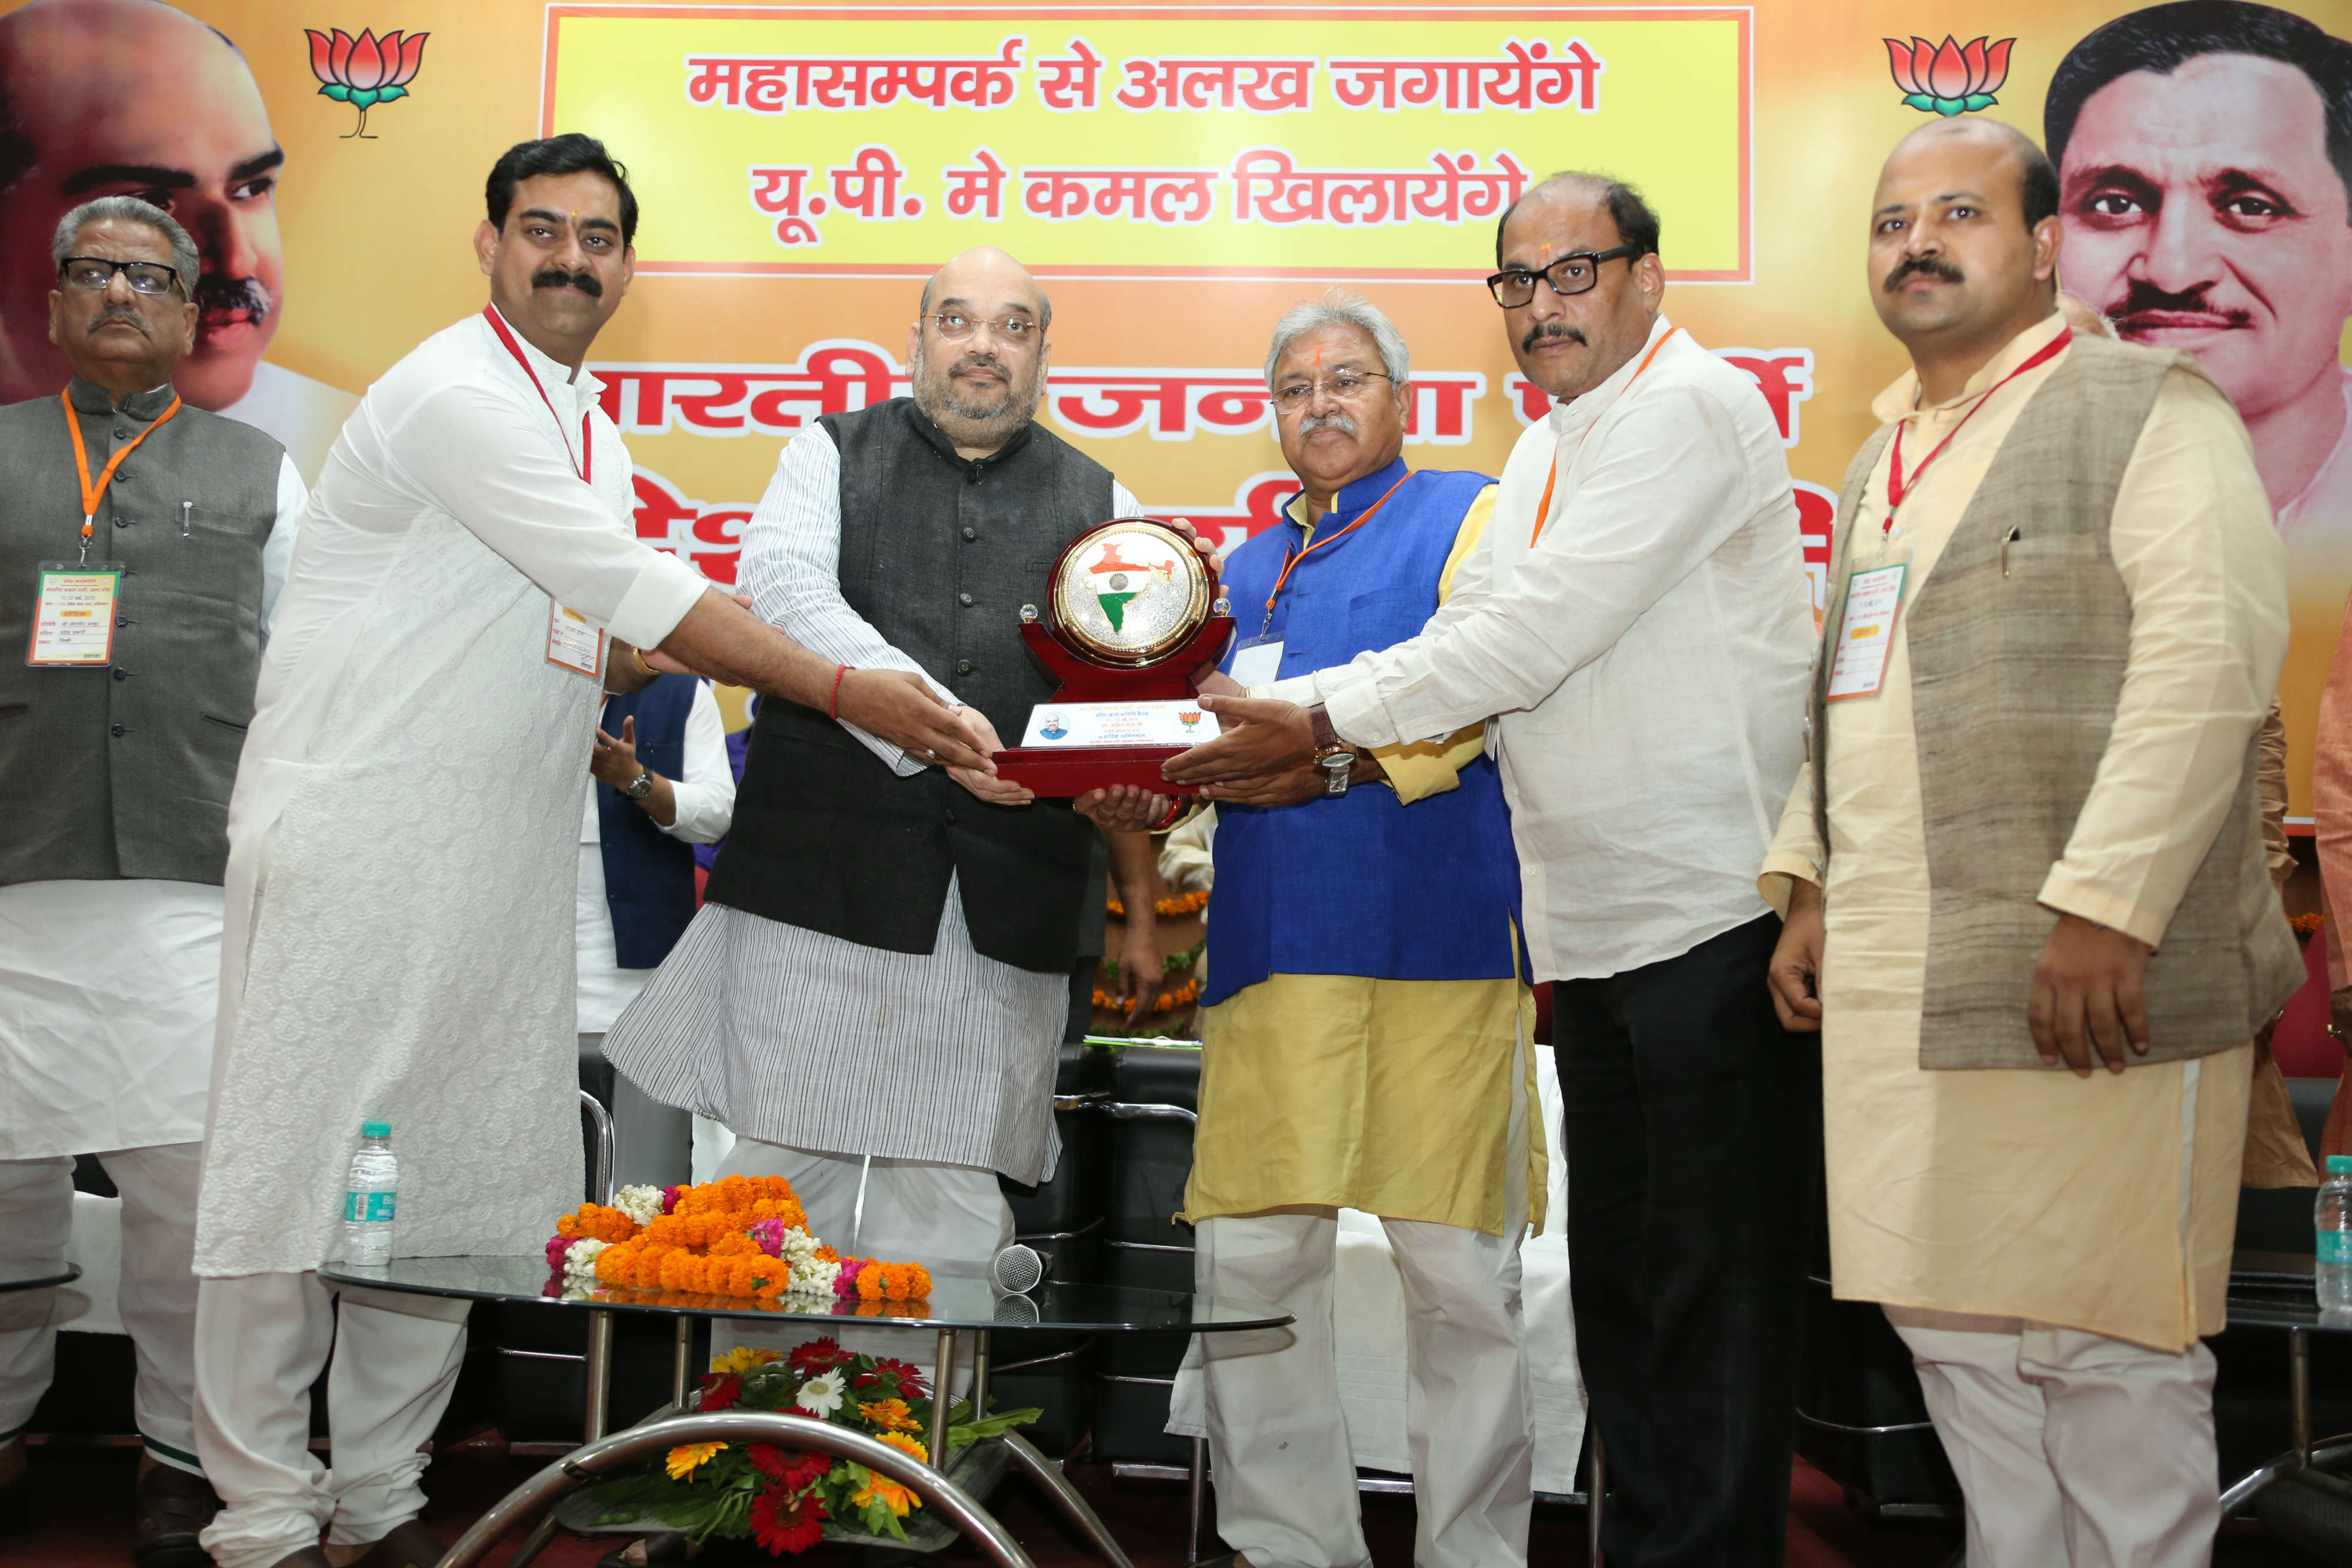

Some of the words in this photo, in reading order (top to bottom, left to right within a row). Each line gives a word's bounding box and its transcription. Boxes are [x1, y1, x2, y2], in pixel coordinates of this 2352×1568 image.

[688, 38, 1024, 112] महासम्पर्क
[1038, 40, 1103, 108] से
[1117, 59, 1315, 109] अलख
[1329, 41, 1601, 111] जगायेंगे
[752, 147, 922, 245] यू.पी.
[1025, 171, 1220, 222] कमल
[1232, 149, 1529, 224] खिलायेंगे
